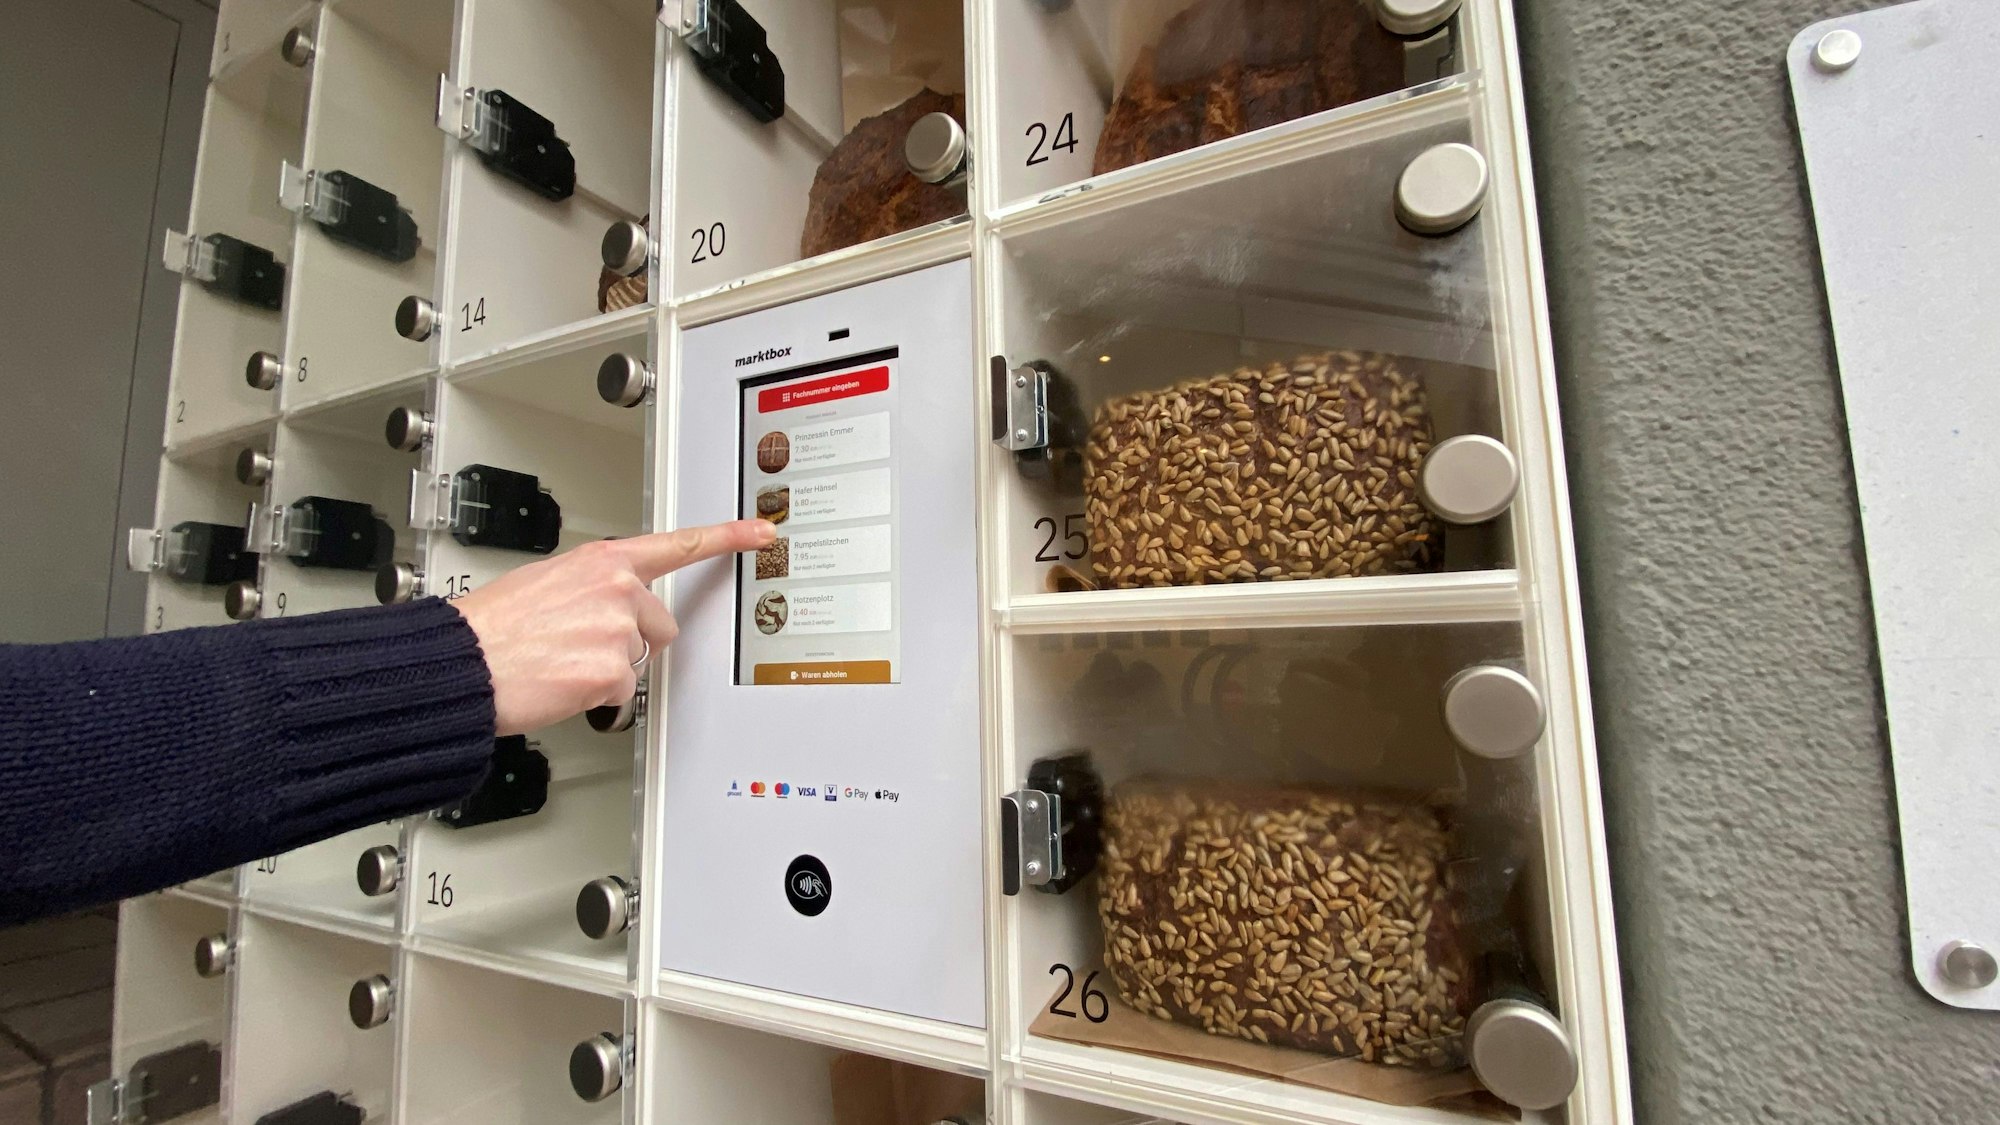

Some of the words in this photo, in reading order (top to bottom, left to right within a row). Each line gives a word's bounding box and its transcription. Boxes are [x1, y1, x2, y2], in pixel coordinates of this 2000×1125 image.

[1025, 111, 1079, 167] 24
[691, 221, 725, 264] 20
[460, 297, 487, 332] 14
[735, 346, 792, 367] marktbox
[297, 356, 308, 383] 8
[792, 386, 831, 400] Fachnummer
[831, 380, 860, 393] eingeben
[176, 399, 186, 424] 2
[794, 430, 829, 442] Prinzessin
[829, 426, 855, 437] Emmer
[794, 486, 813, 495] Hafer
[813, 482, 838, 492] Hänsel
[794, 537, 849, 549] Rumpelstilzchen
[1034, 513, 1089, 562] 25
[446, 575, 471, 600] 15
[793, 594, 834, 604] Hotzenplotz
[277, 592, 287, 617] 9
[155, 605, 164, 630] 3
[801, 671, 822, 679] Waren
[822, 670, 848, 679] abholen
[797, 786, 817, 797] VISA
[854, 788, 869, 801] Pay
[882, 789, 900, 803] Pay
[427, 871, 454, 908] 16
[1048, 963, 1109, 1023] 26
